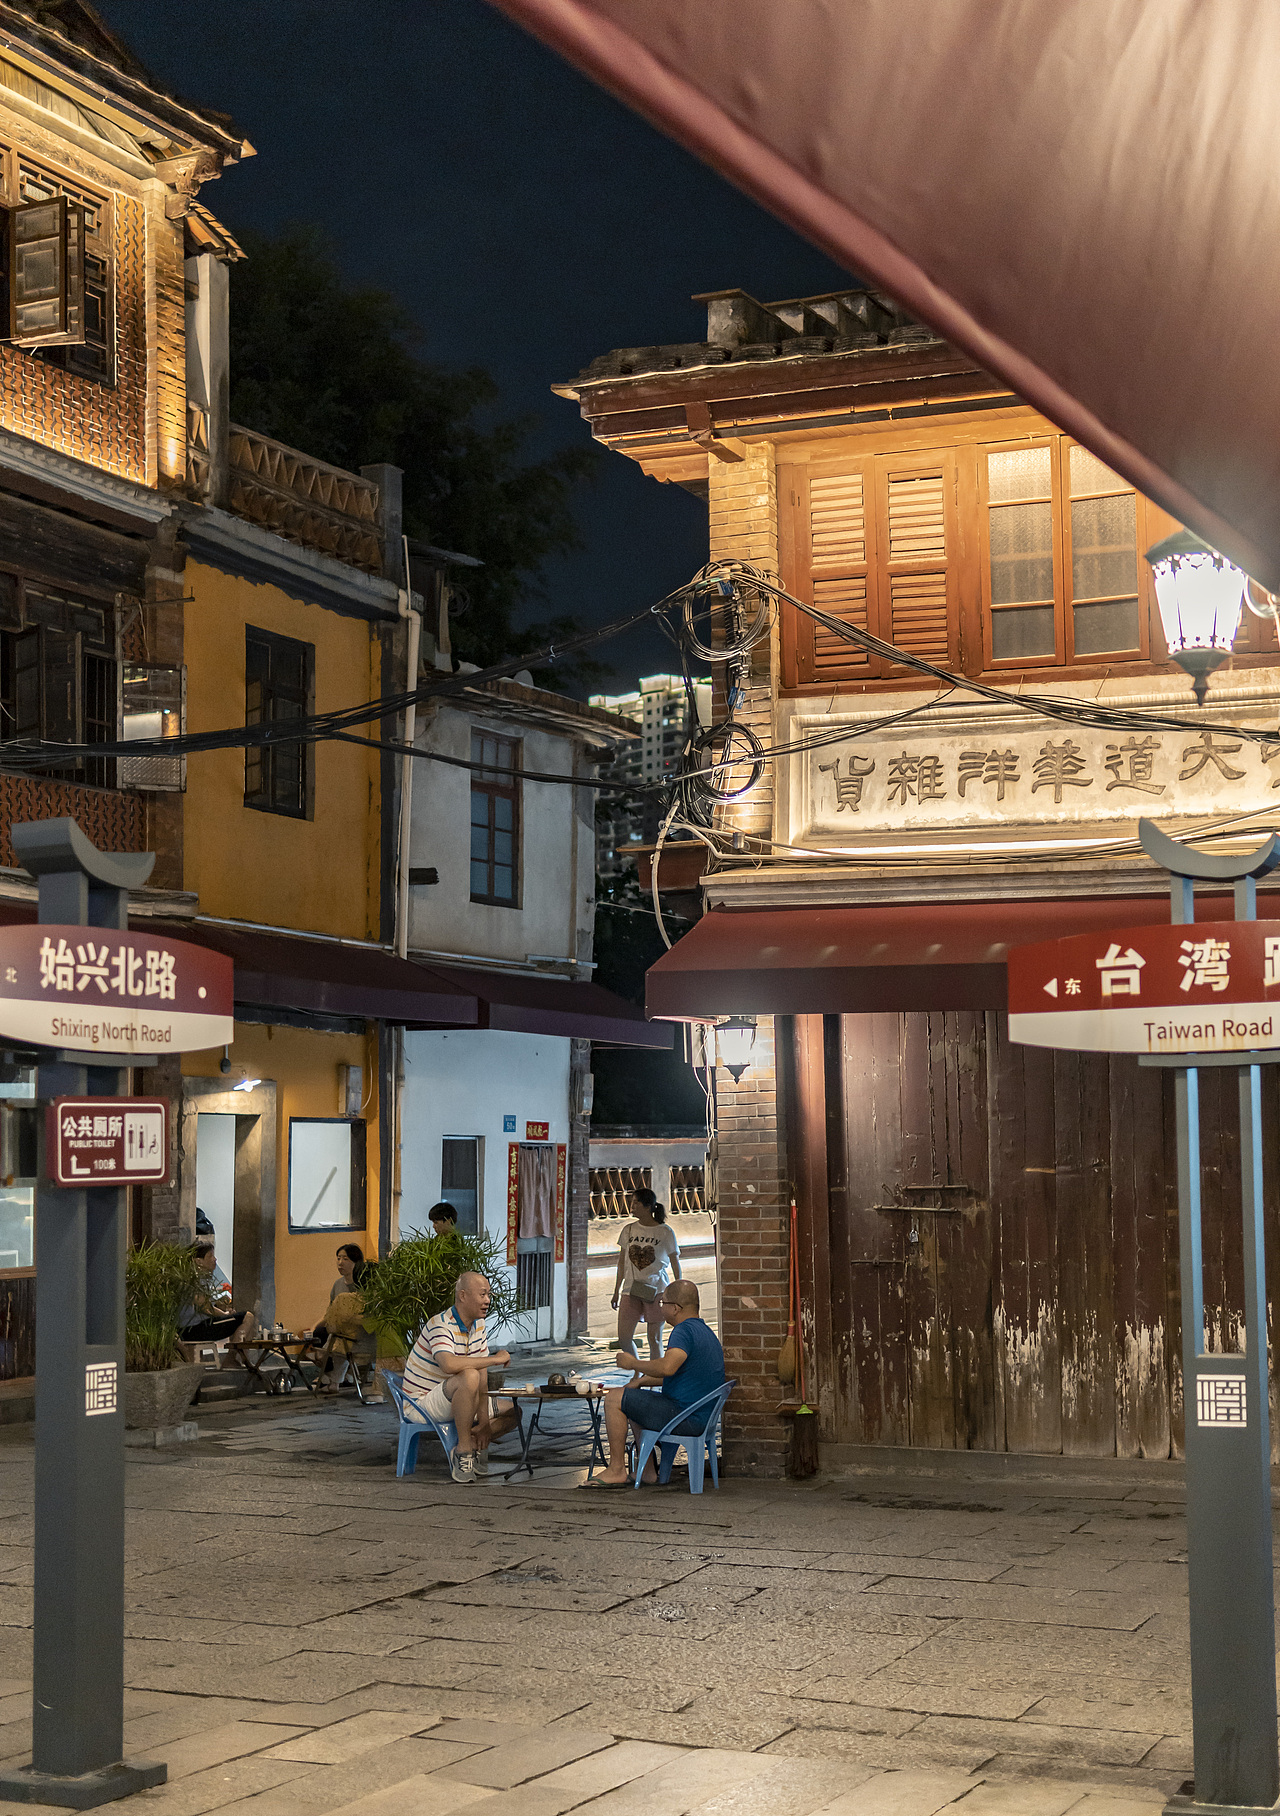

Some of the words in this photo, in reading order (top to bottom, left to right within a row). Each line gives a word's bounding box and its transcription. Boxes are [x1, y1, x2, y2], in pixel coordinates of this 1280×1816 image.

[5, 967, 18, 983] 北
[39, 936, 178, 1000] 始兴北路
[1064, 978, 1082, 995] 东
[51, 1017, 99, 1043] Shixing
[102, 1021, 138, 1041] North
[141, 1024, 172, 1043] Road
[1143, 1020, 1216, 1040] Taiwan
[1222, 1016, 1273, 1037] Road
[62, 1115, 123, 1138] 公共厕所
[69, 1139, 93, 1148] PUBLIC
[94, 1139, 115, 1148] TOILET
[93, 1158, 116, 1170] 100米
